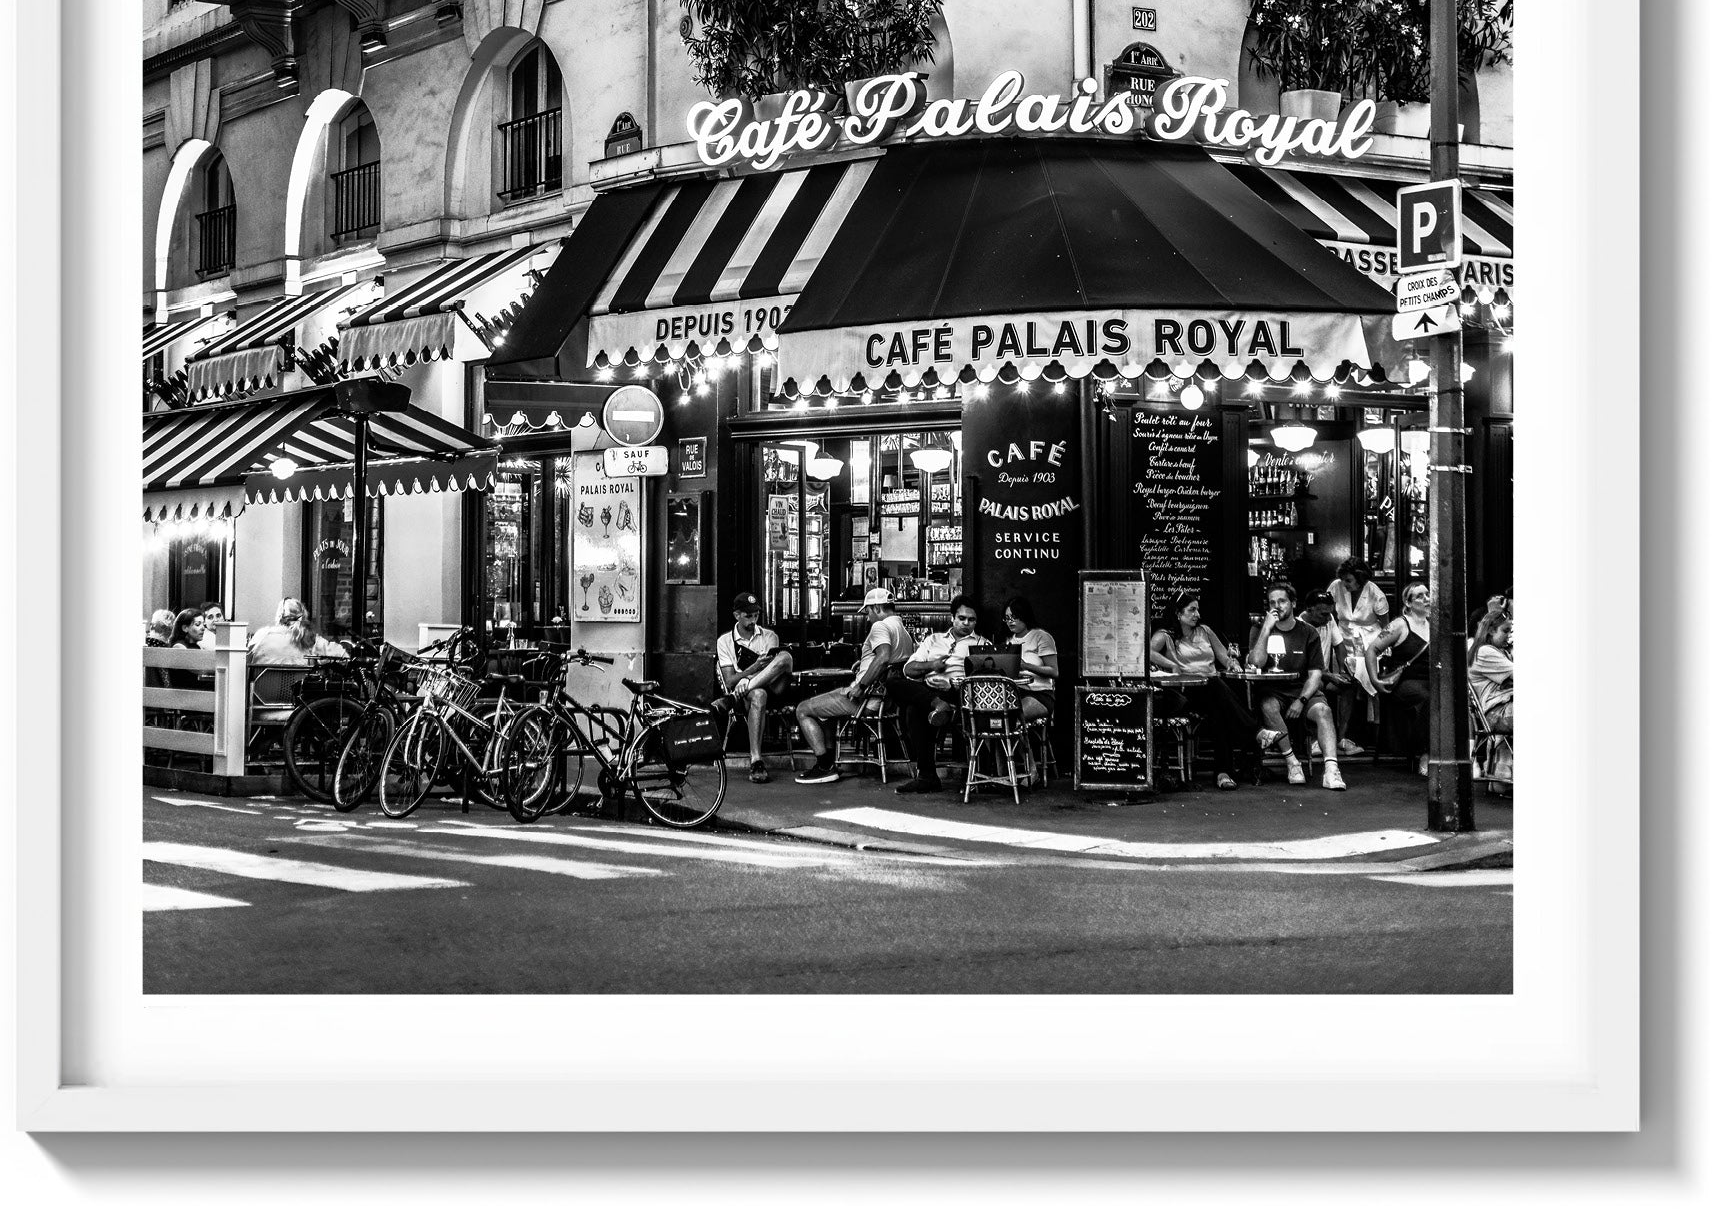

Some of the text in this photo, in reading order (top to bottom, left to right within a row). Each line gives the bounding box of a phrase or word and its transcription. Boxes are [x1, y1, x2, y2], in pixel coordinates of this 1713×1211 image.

[1135, 10, 1154, 28] 202
[1130, 77, 1155, 92] RUE
[687, 70, 1377, 170] Café Palais Royal
[616, 143, 631, 155] RUE
[1413, 201, 1437, 254] P
[1407, 277, 1439, 292] CROIX DES
[1400, 285, 1455, 307] PETITS CHAMPS
[656, 312, 734, 342] DEPUIS
[866, 318, 1305, 369] CAFÉ PALAIS ROYAL
[1134, 411, 1160, 424] Poulet
[1190, 414, 1213, 432] four
[624, 450, 650, 459] SAUF
[685, 444, 699, 455] RUE
[987, 440, 1067, 468] CAFÉ
[1264, 451, 1289, 466] Vente
[682, 461, 702, 472] VALOIS
[998, 472, 1056, 488] Depuis 1903
[580, 483, 634, 495] PALAIS ROYAL
[979, 496, 1080, 521] PALAIS ROYAL
[995, 532, 1060, 543] SERVICE
[994, 548, 1060, 559] CONTINU
